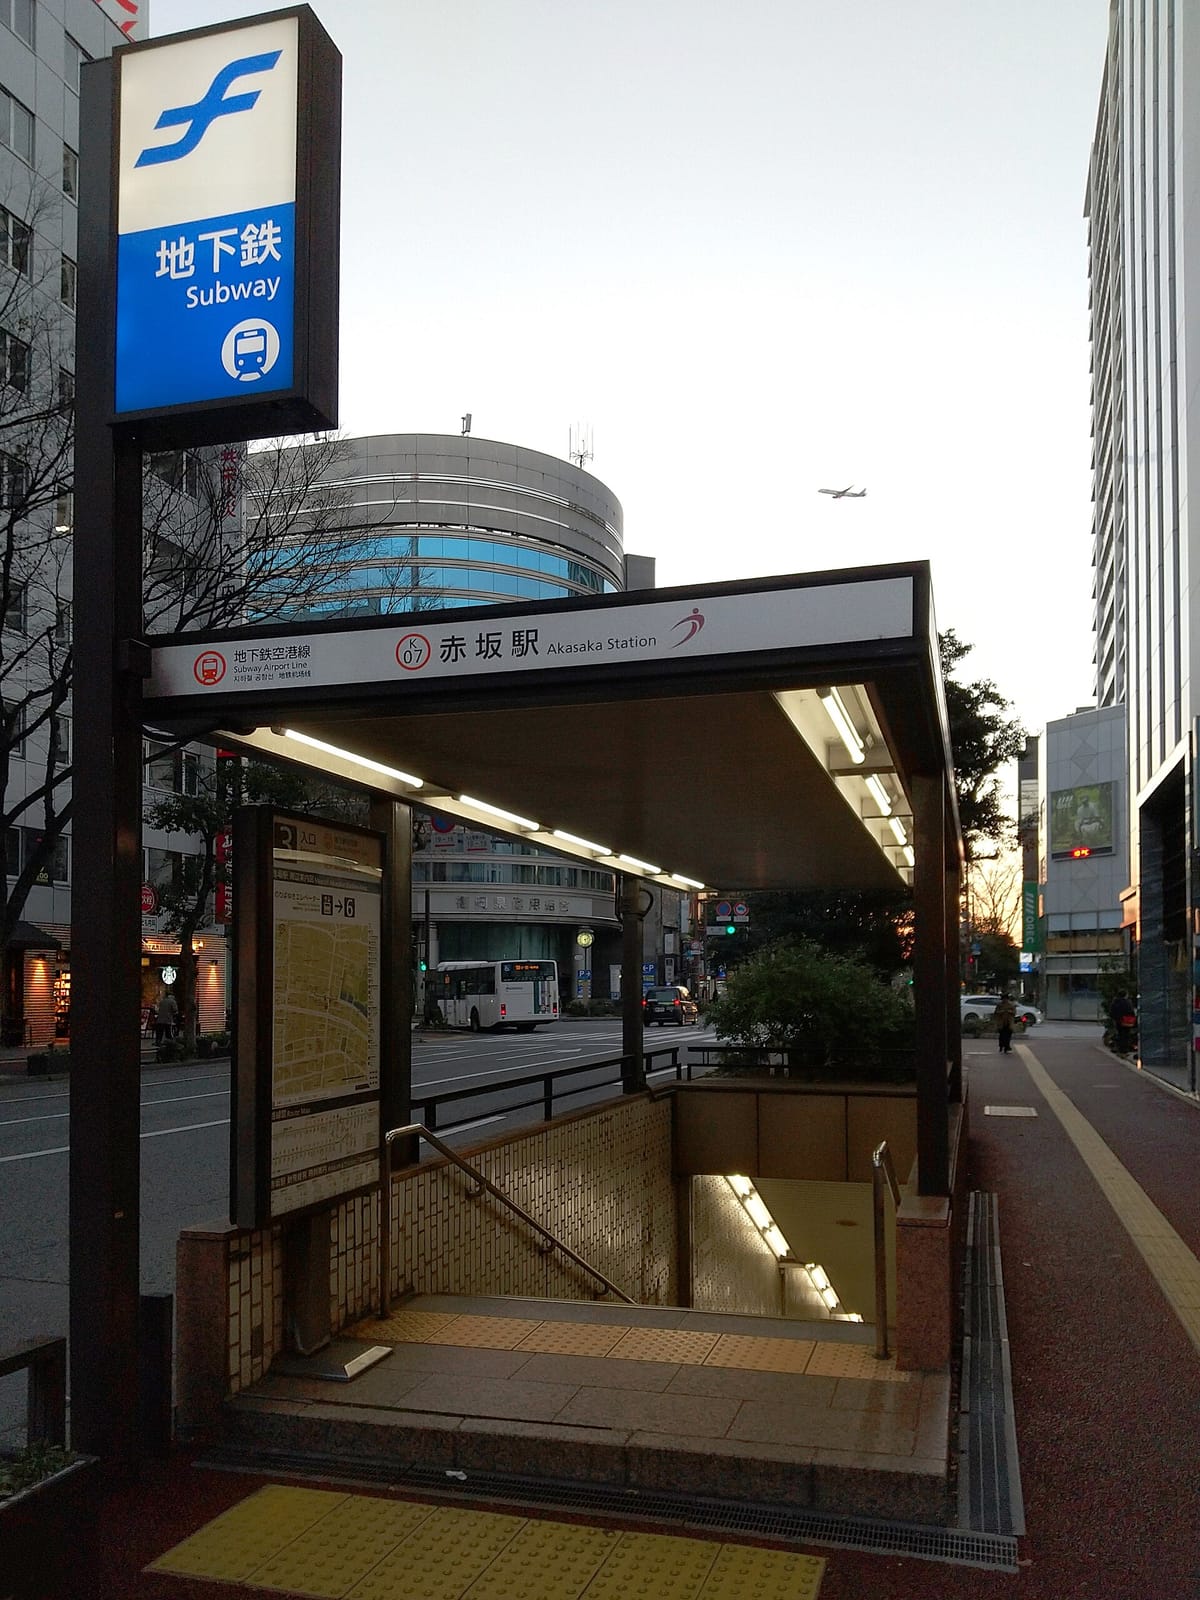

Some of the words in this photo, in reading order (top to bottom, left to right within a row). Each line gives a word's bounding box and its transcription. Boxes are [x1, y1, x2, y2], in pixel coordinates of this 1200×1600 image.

[155, 220, 282, 280] 地下鉄
[186, 276, 281, 309] Subway
[409, 639, 417, 649] K
[439, 629, 539, 664] 赤坂駅
[547, 640, 603, 655] Akasaka
[607, 635, 657, 650] Station
[234, 645, 311, 663] 地下鉄空港線
[403, 649, 423, 664] 07
[233, 664, 262, 674] Subway
[263, 662, 290, 672] Airport
[292, 661, 308, 669] Line
[301, 833, 317, 846] 入口
[346, 898, 354, 917] 6
[1026, 916, 1034, 944] OREC
